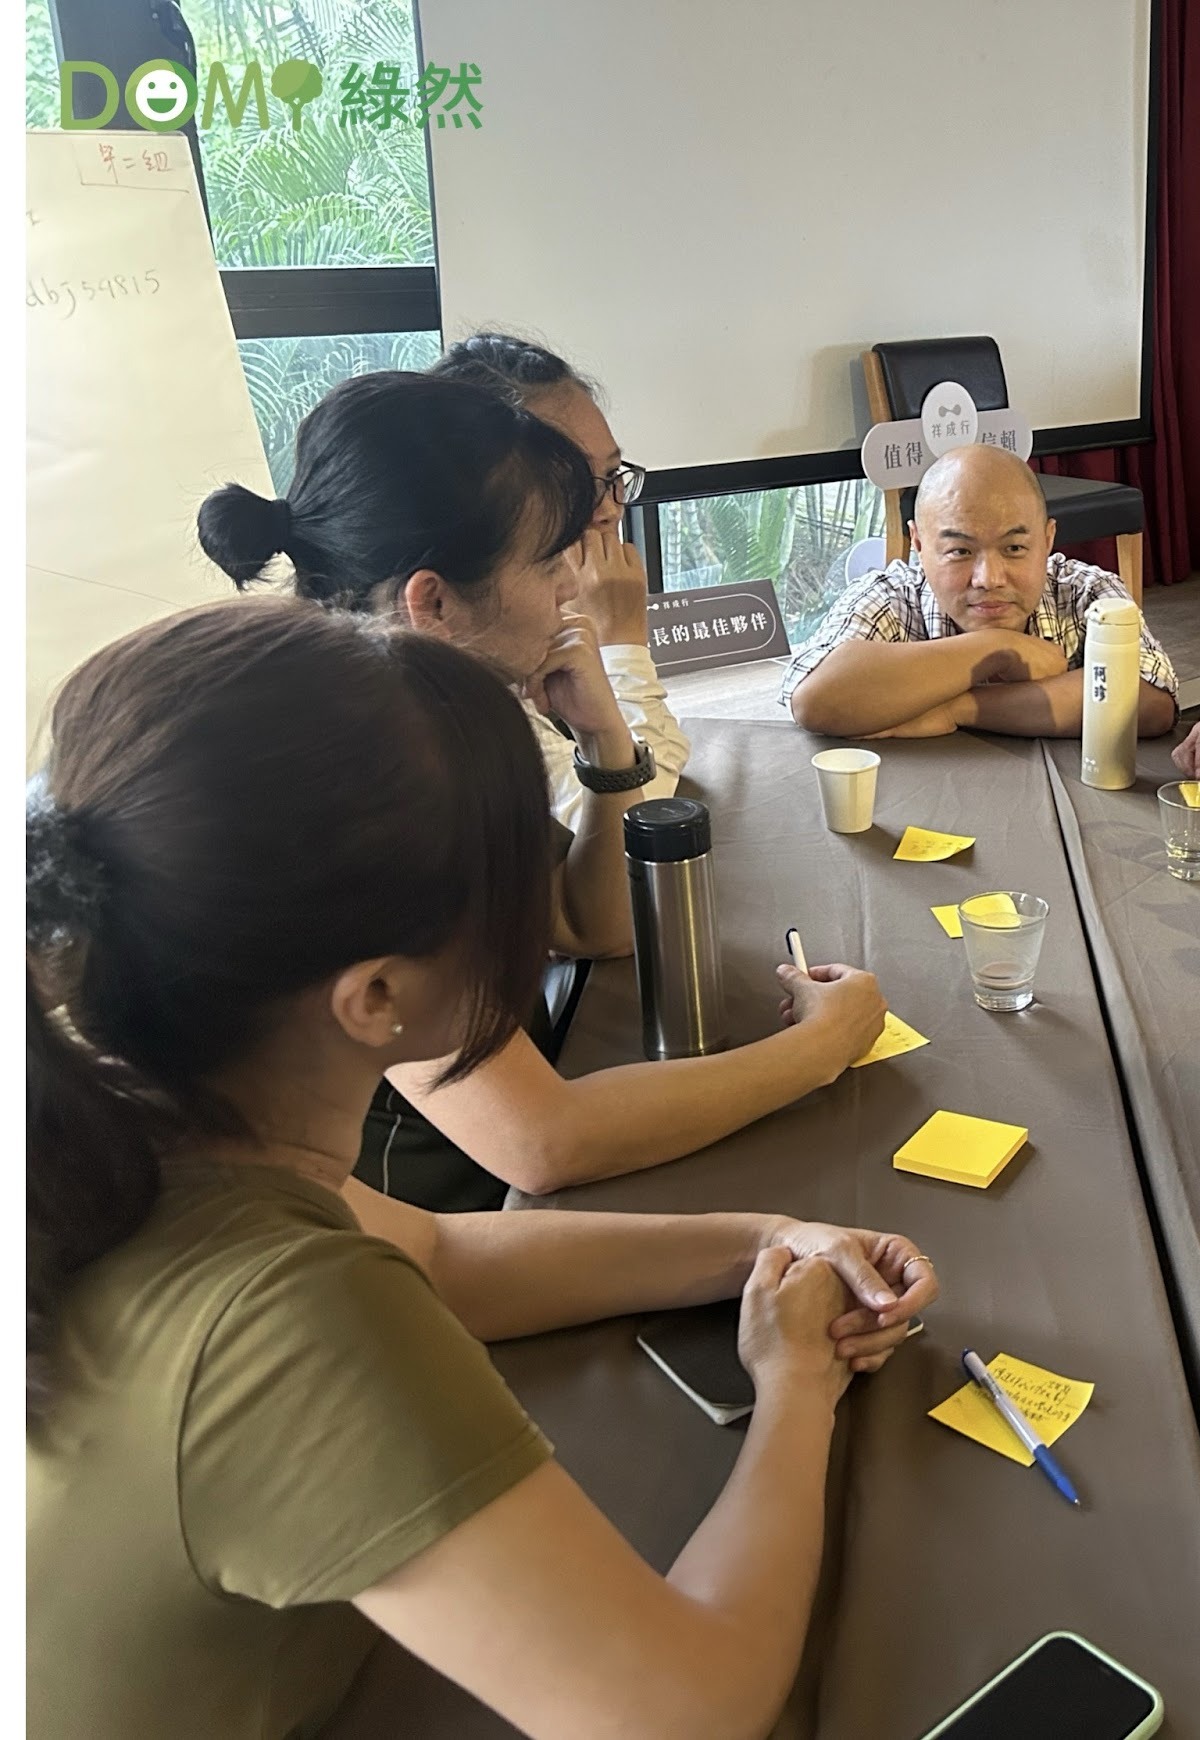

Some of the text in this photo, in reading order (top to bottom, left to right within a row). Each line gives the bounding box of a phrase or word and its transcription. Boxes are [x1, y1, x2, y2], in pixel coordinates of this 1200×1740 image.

[931, 419, 971, 439] 祥成行
[981, 429, 1017, 453] 信賴
[884, 441, 923, 470] 值得
[647, 611, 768, 648] 長的最佳夥伴
